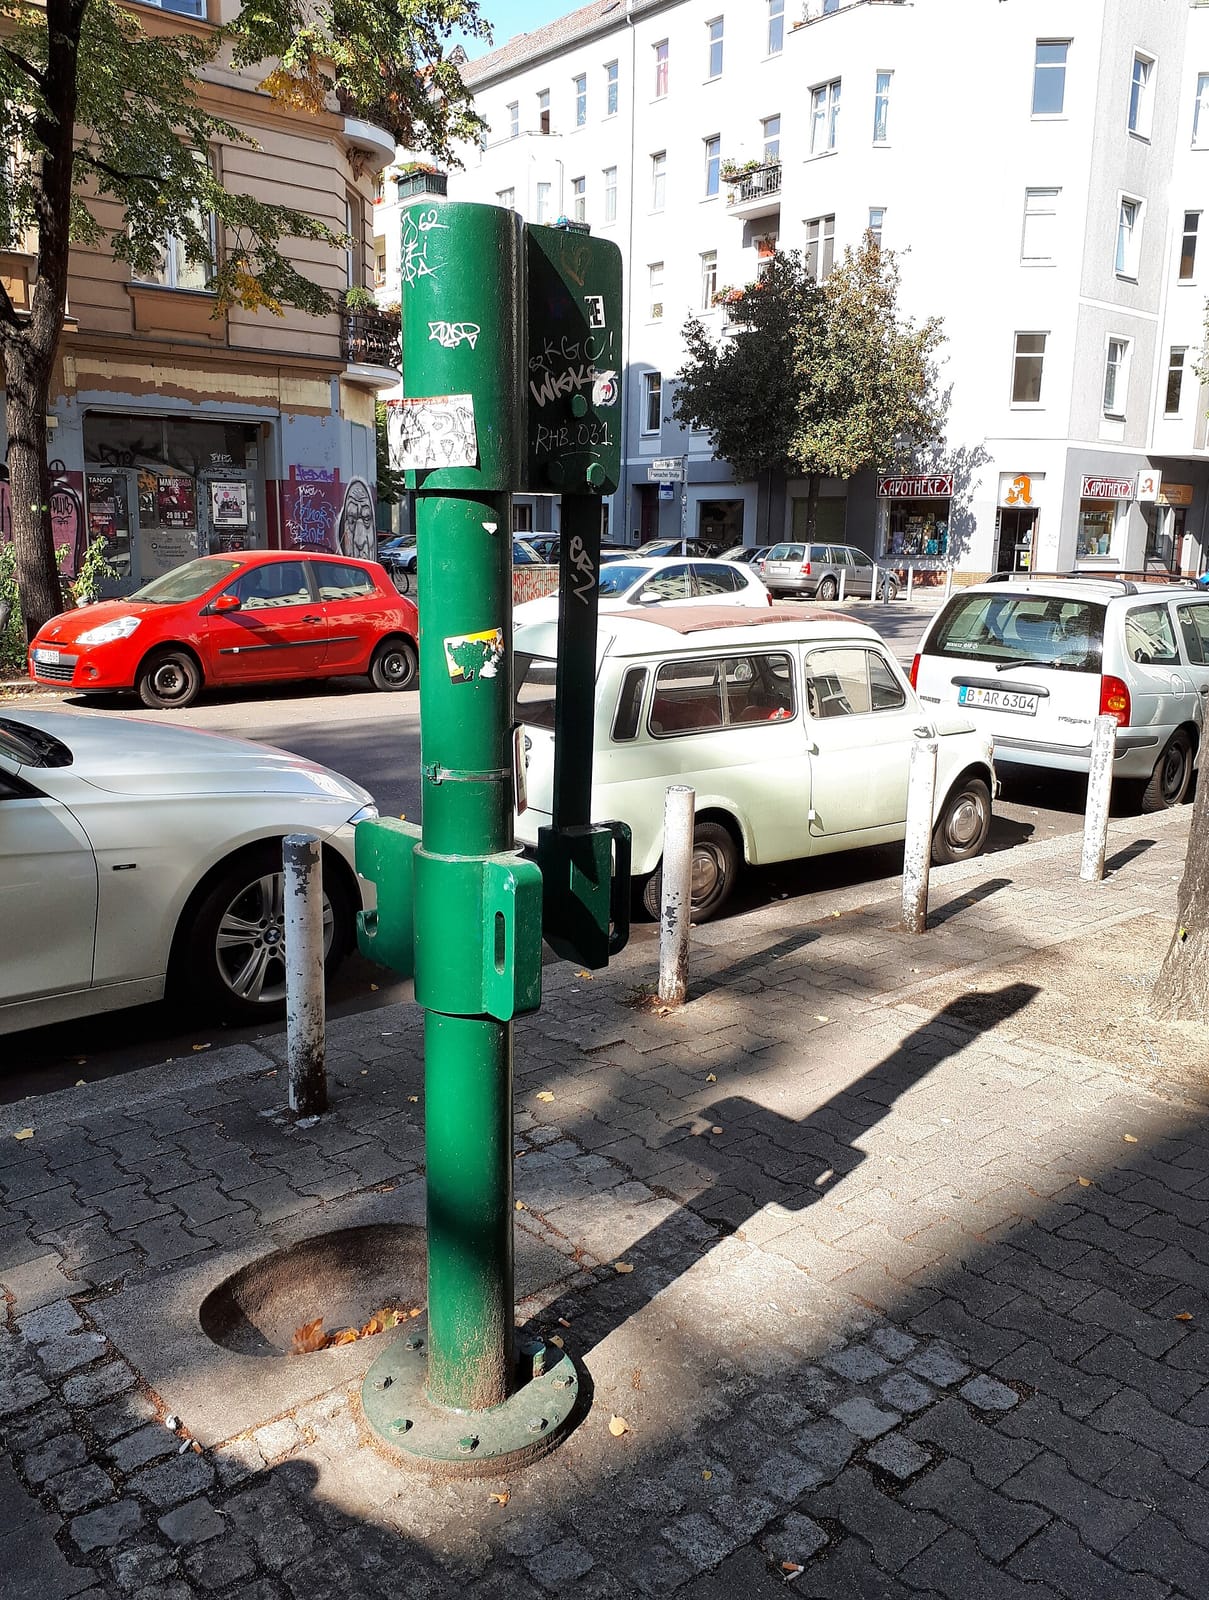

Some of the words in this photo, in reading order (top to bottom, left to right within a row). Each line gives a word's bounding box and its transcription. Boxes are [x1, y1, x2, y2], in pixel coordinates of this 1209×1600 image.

[88, 476, 113, 484] TANGO
[888, 479, 942, 496] APOTHEKE
[1090, 481, 1128, 497] APOTHEKE
[966, 689, 975, 702] B
[982, 691, 1000, 705] AR
[1001, 694, 1035, 710] 6304
